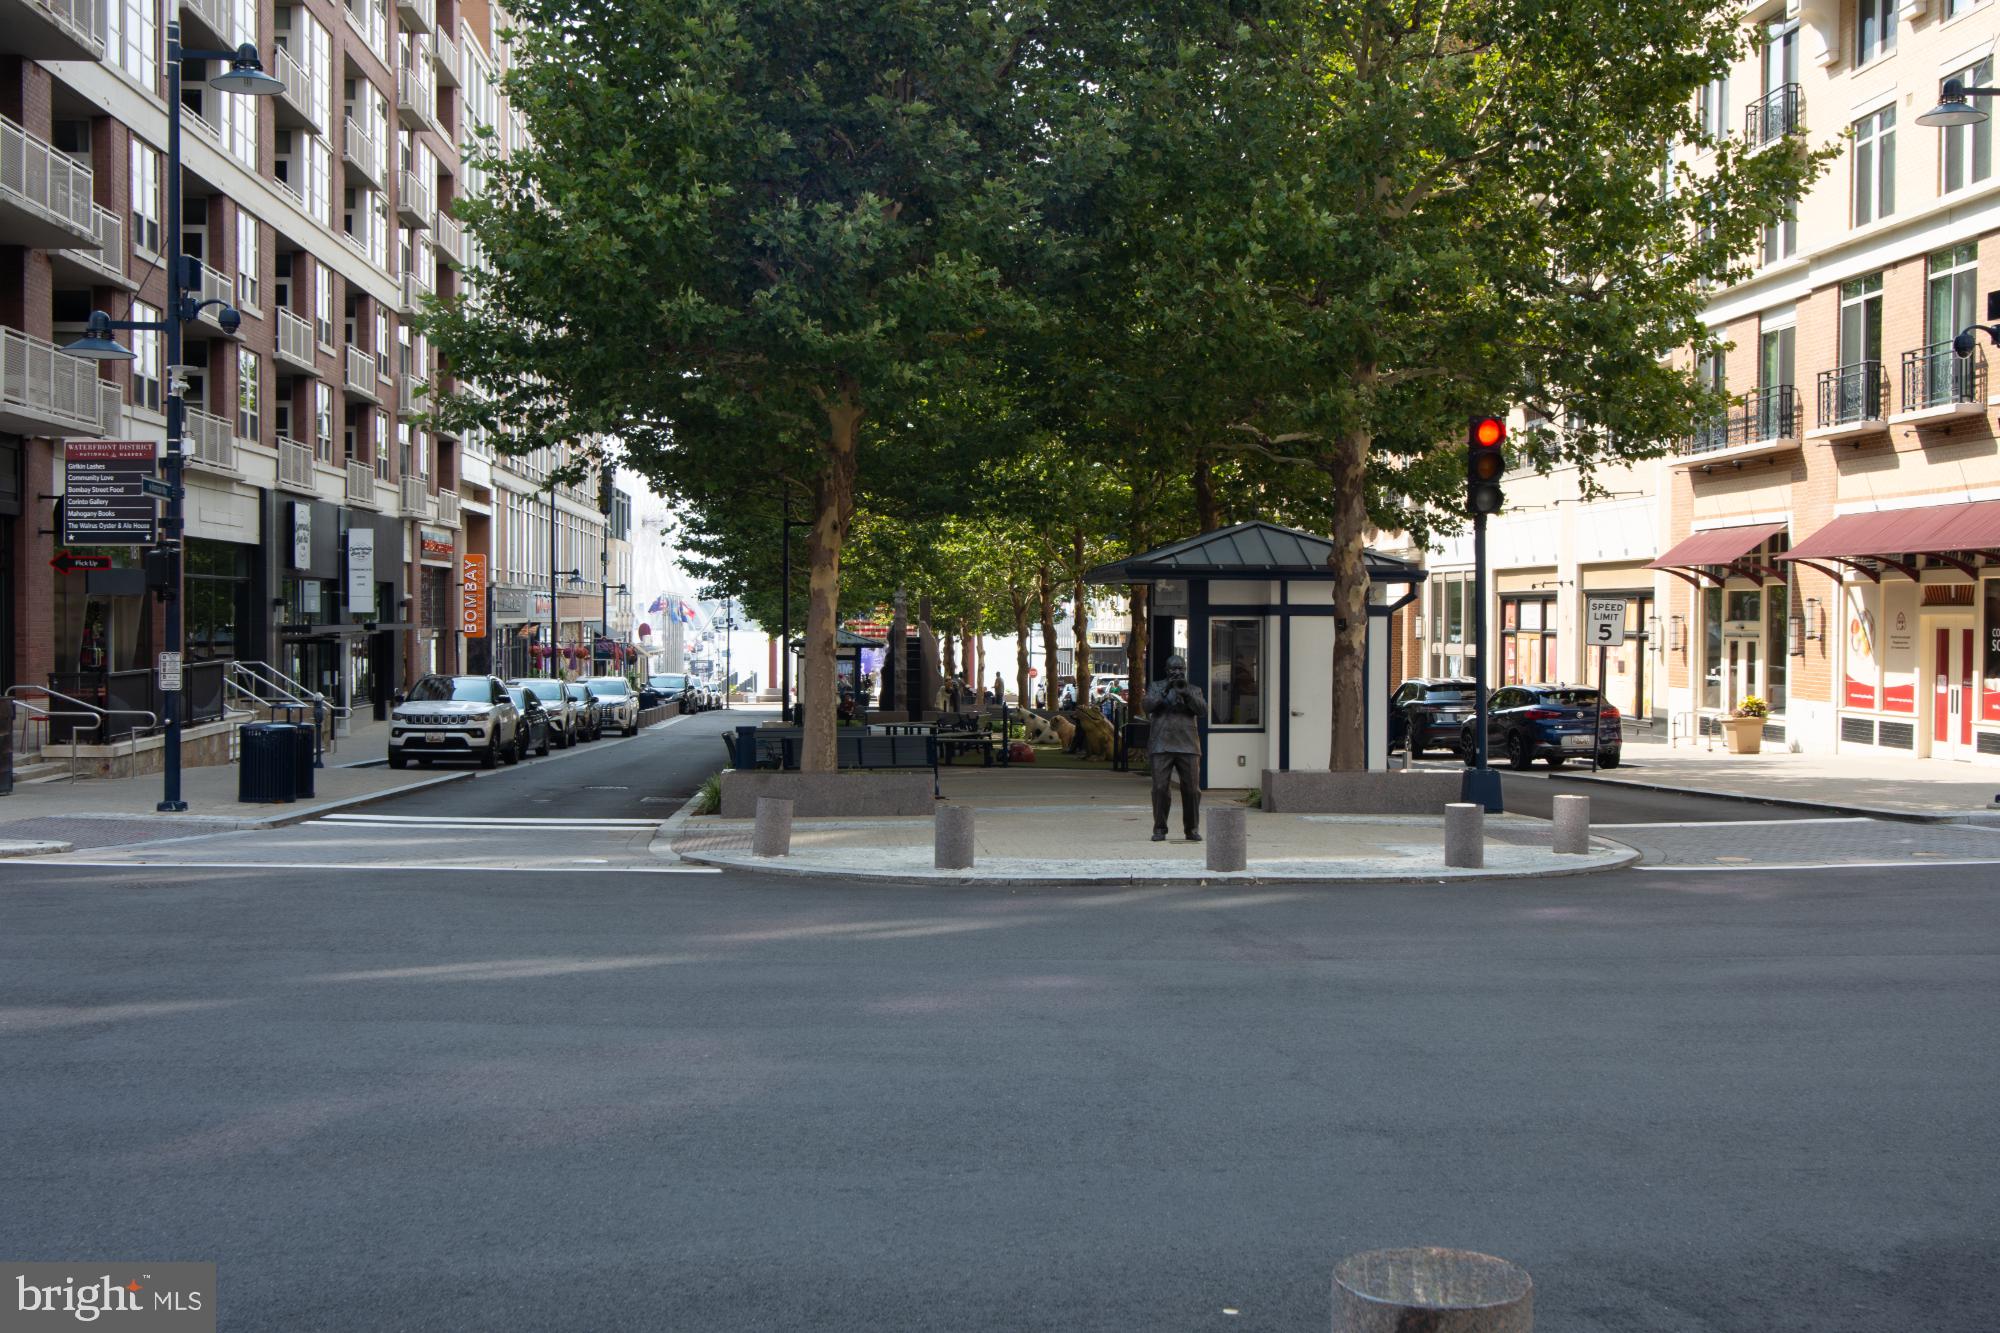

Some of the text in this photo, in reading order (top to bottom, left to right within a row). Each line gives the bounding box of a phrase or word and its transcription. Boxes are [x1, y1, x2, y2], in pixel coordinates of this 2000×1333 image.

[464, 560, 477, 632] BOMBAY
[1592, 603, 1624, 611] SPEED
[1594, 613, 1619, 621] LIMIT
[1598, 624, 1612, 640] 5
